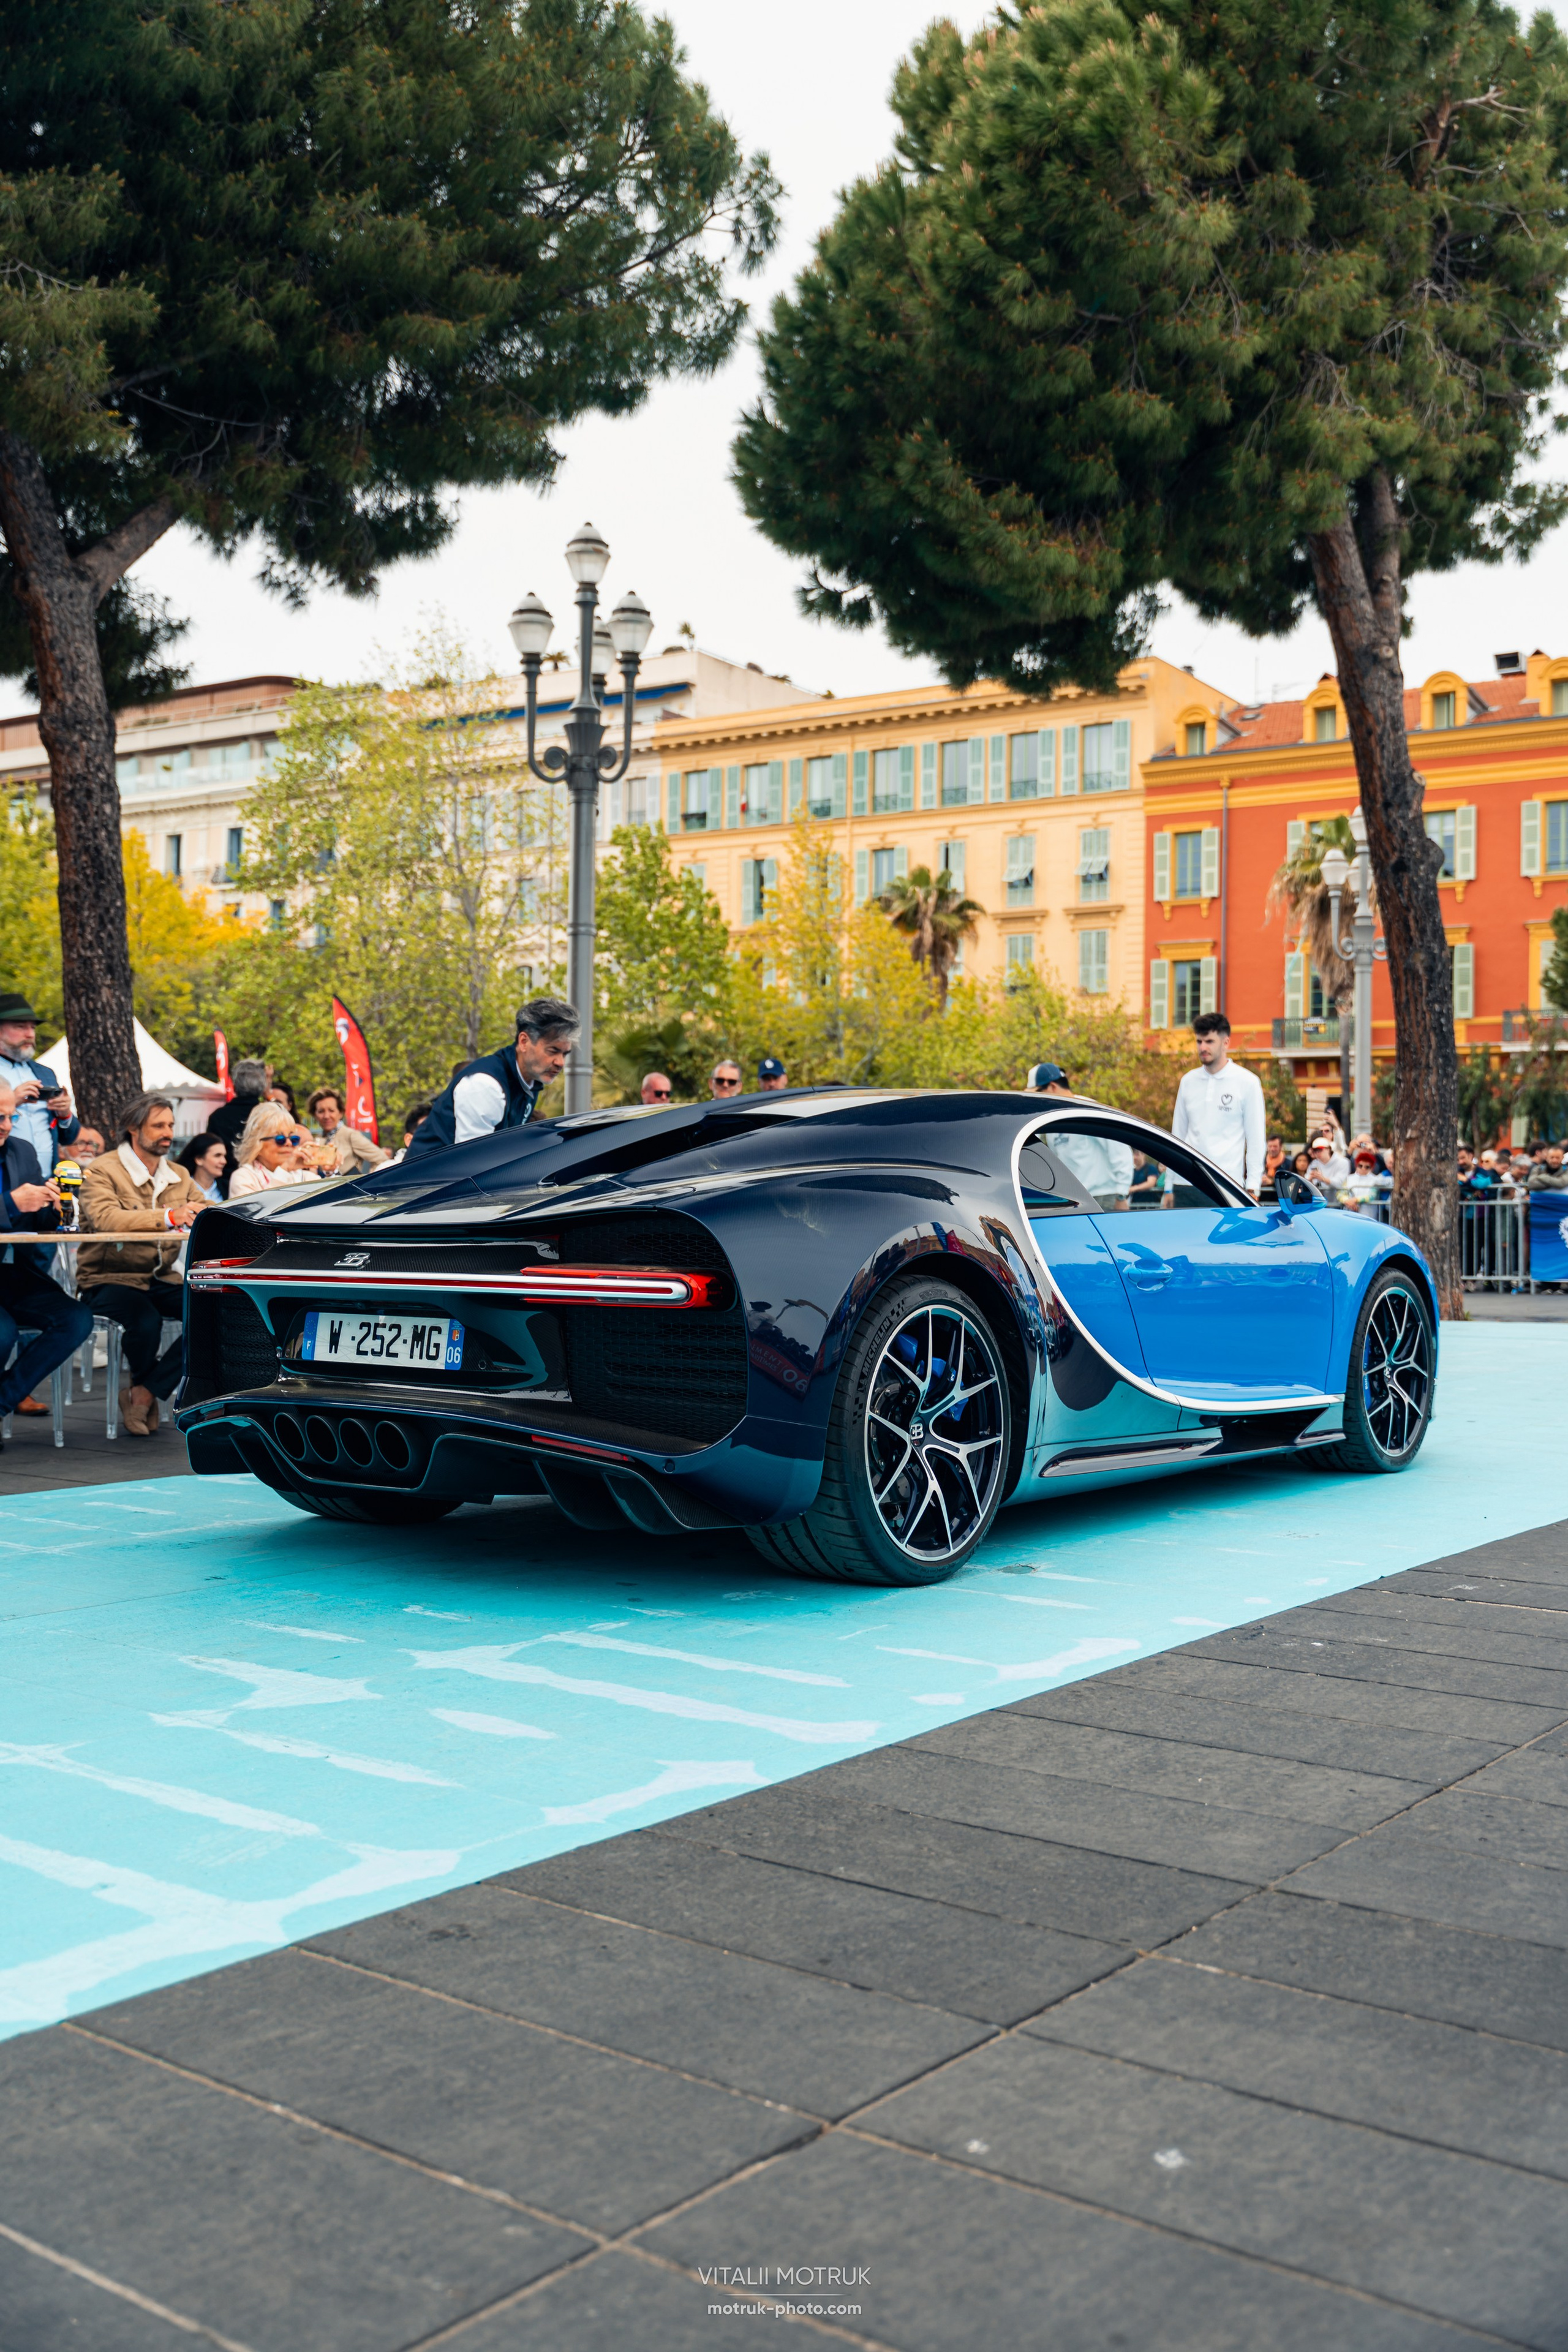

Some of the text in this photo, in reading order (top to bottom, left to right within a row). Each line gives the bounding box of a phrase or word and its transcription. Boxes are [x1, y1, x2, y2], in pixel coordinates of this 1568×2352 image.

[306, 1341, 311, 1349] F
[862, 1319, 892, 1376] MICHELIN
[446, 1347, 461, 1363] 06
